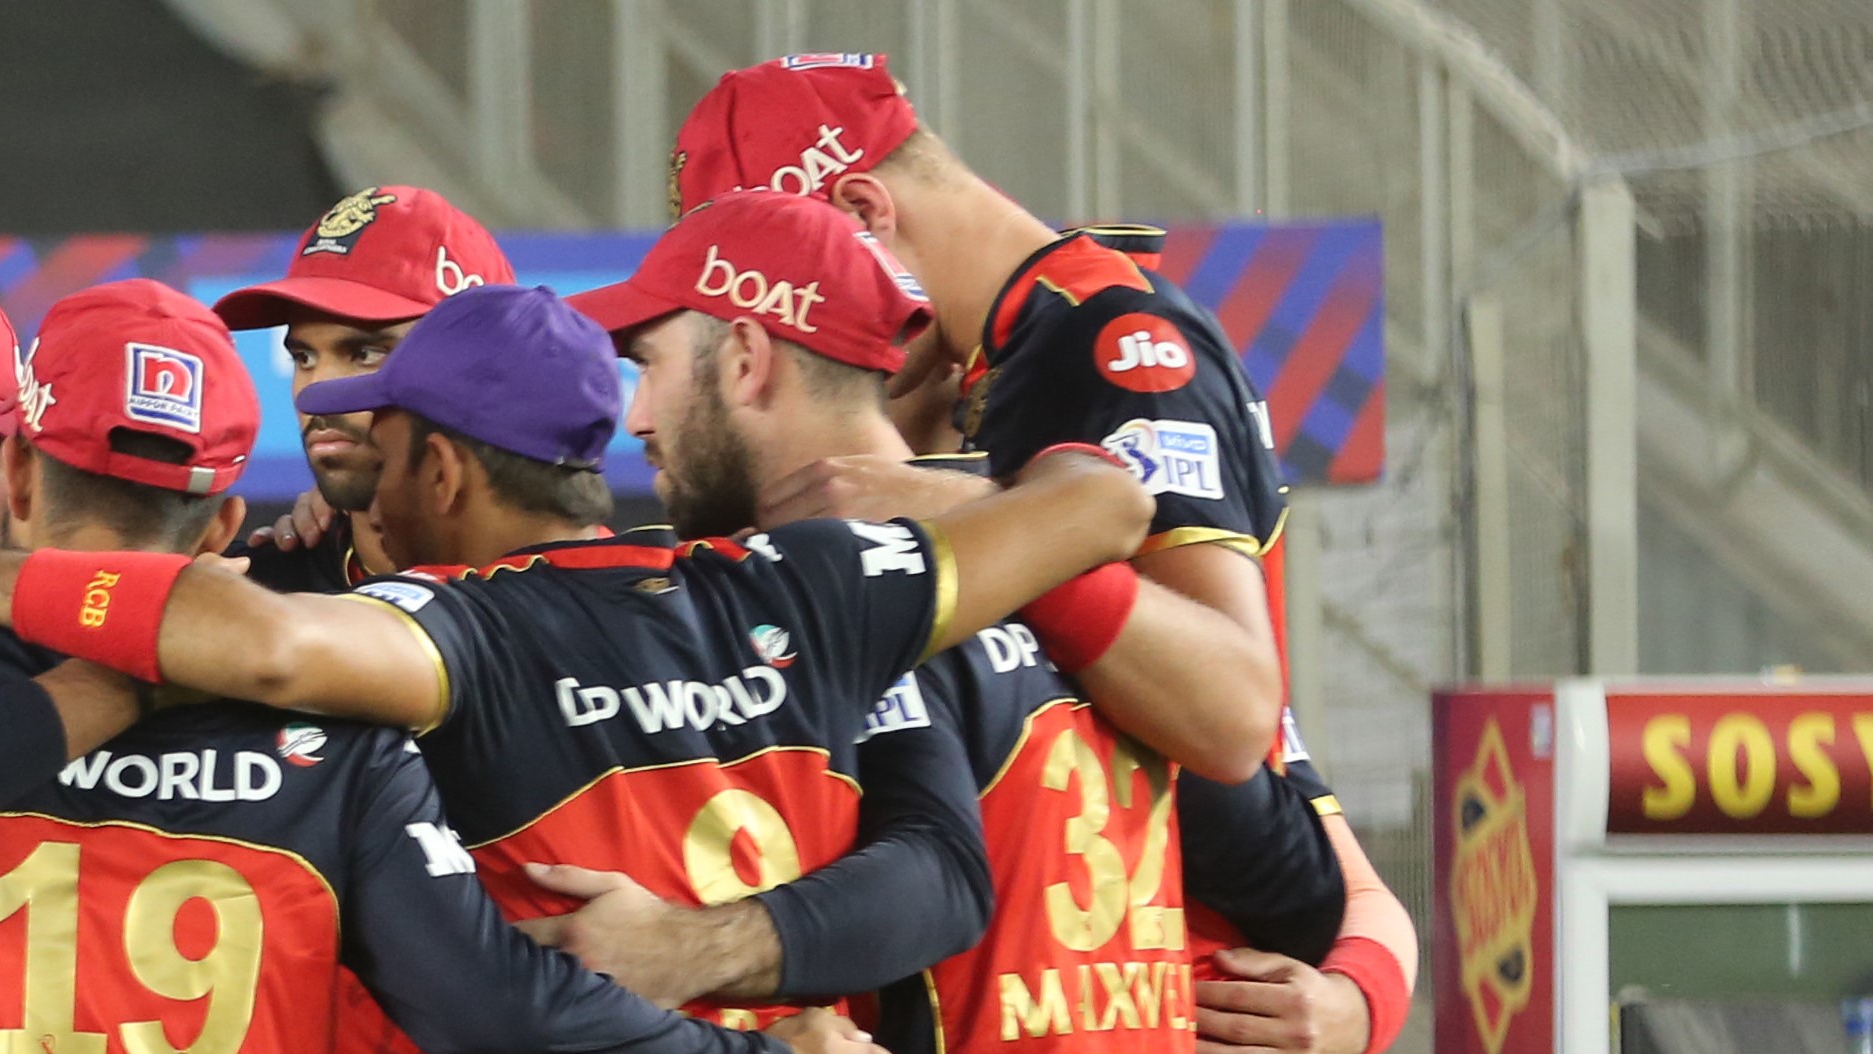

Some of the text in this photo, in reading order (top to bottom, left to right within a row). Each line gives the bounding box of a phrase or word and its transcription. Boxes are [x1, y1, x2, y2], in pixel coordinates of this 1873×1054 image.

[733, 124, 864, 197] oAt
[1108, 331, 1188, 372] Jio
[1162, 454, 1217, 492] IPL
[80, 569, 121, 628] RCB
[976, 623, 1039, 673] DP
[623, 665, 787, 734] WORLD
[58, 749, 283, 801] WORLD
[1043, 729, 1185, 952] 32
